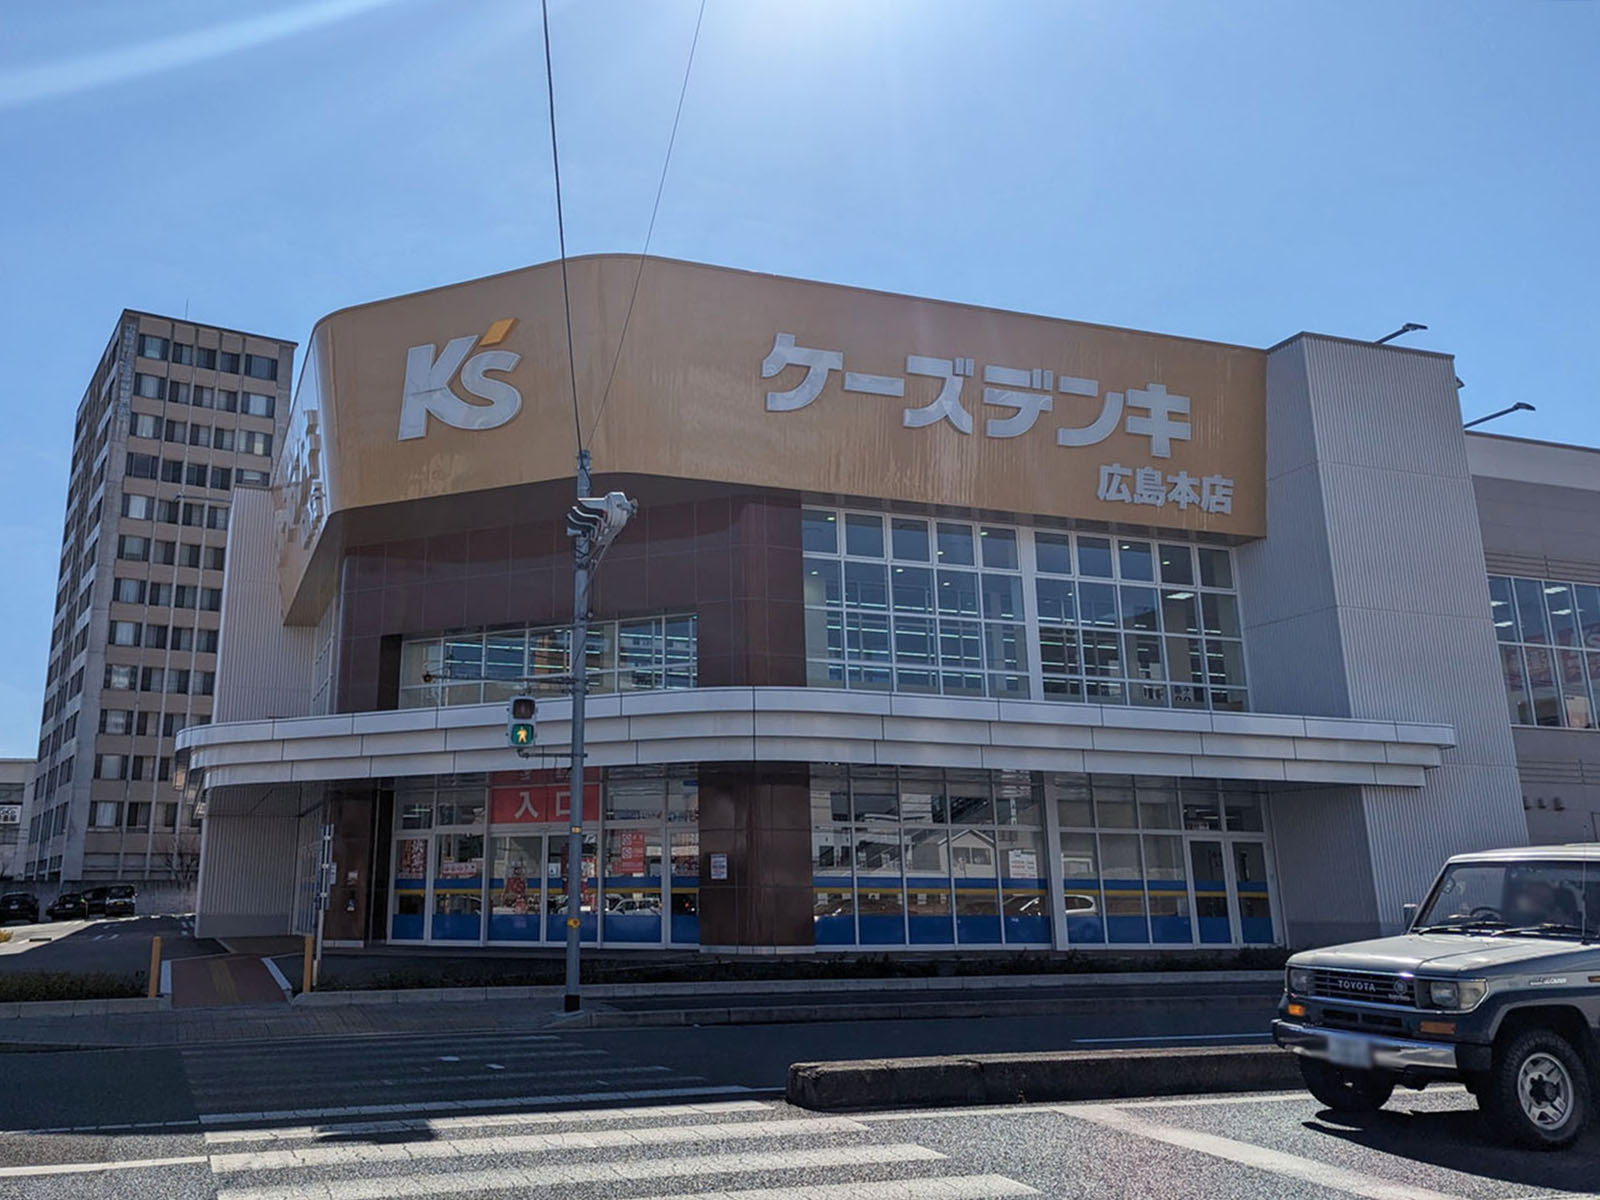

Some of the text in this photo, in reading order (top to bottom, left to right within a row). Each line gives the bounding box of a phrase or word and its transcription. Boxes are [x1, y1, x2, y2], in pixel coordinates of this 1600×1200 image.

[762, 333, 1192, 457] ケーズデンキ
[1097, 465, 1234, 514] 広島本店
[1338, 980, 1376, 992] TOYOTA
